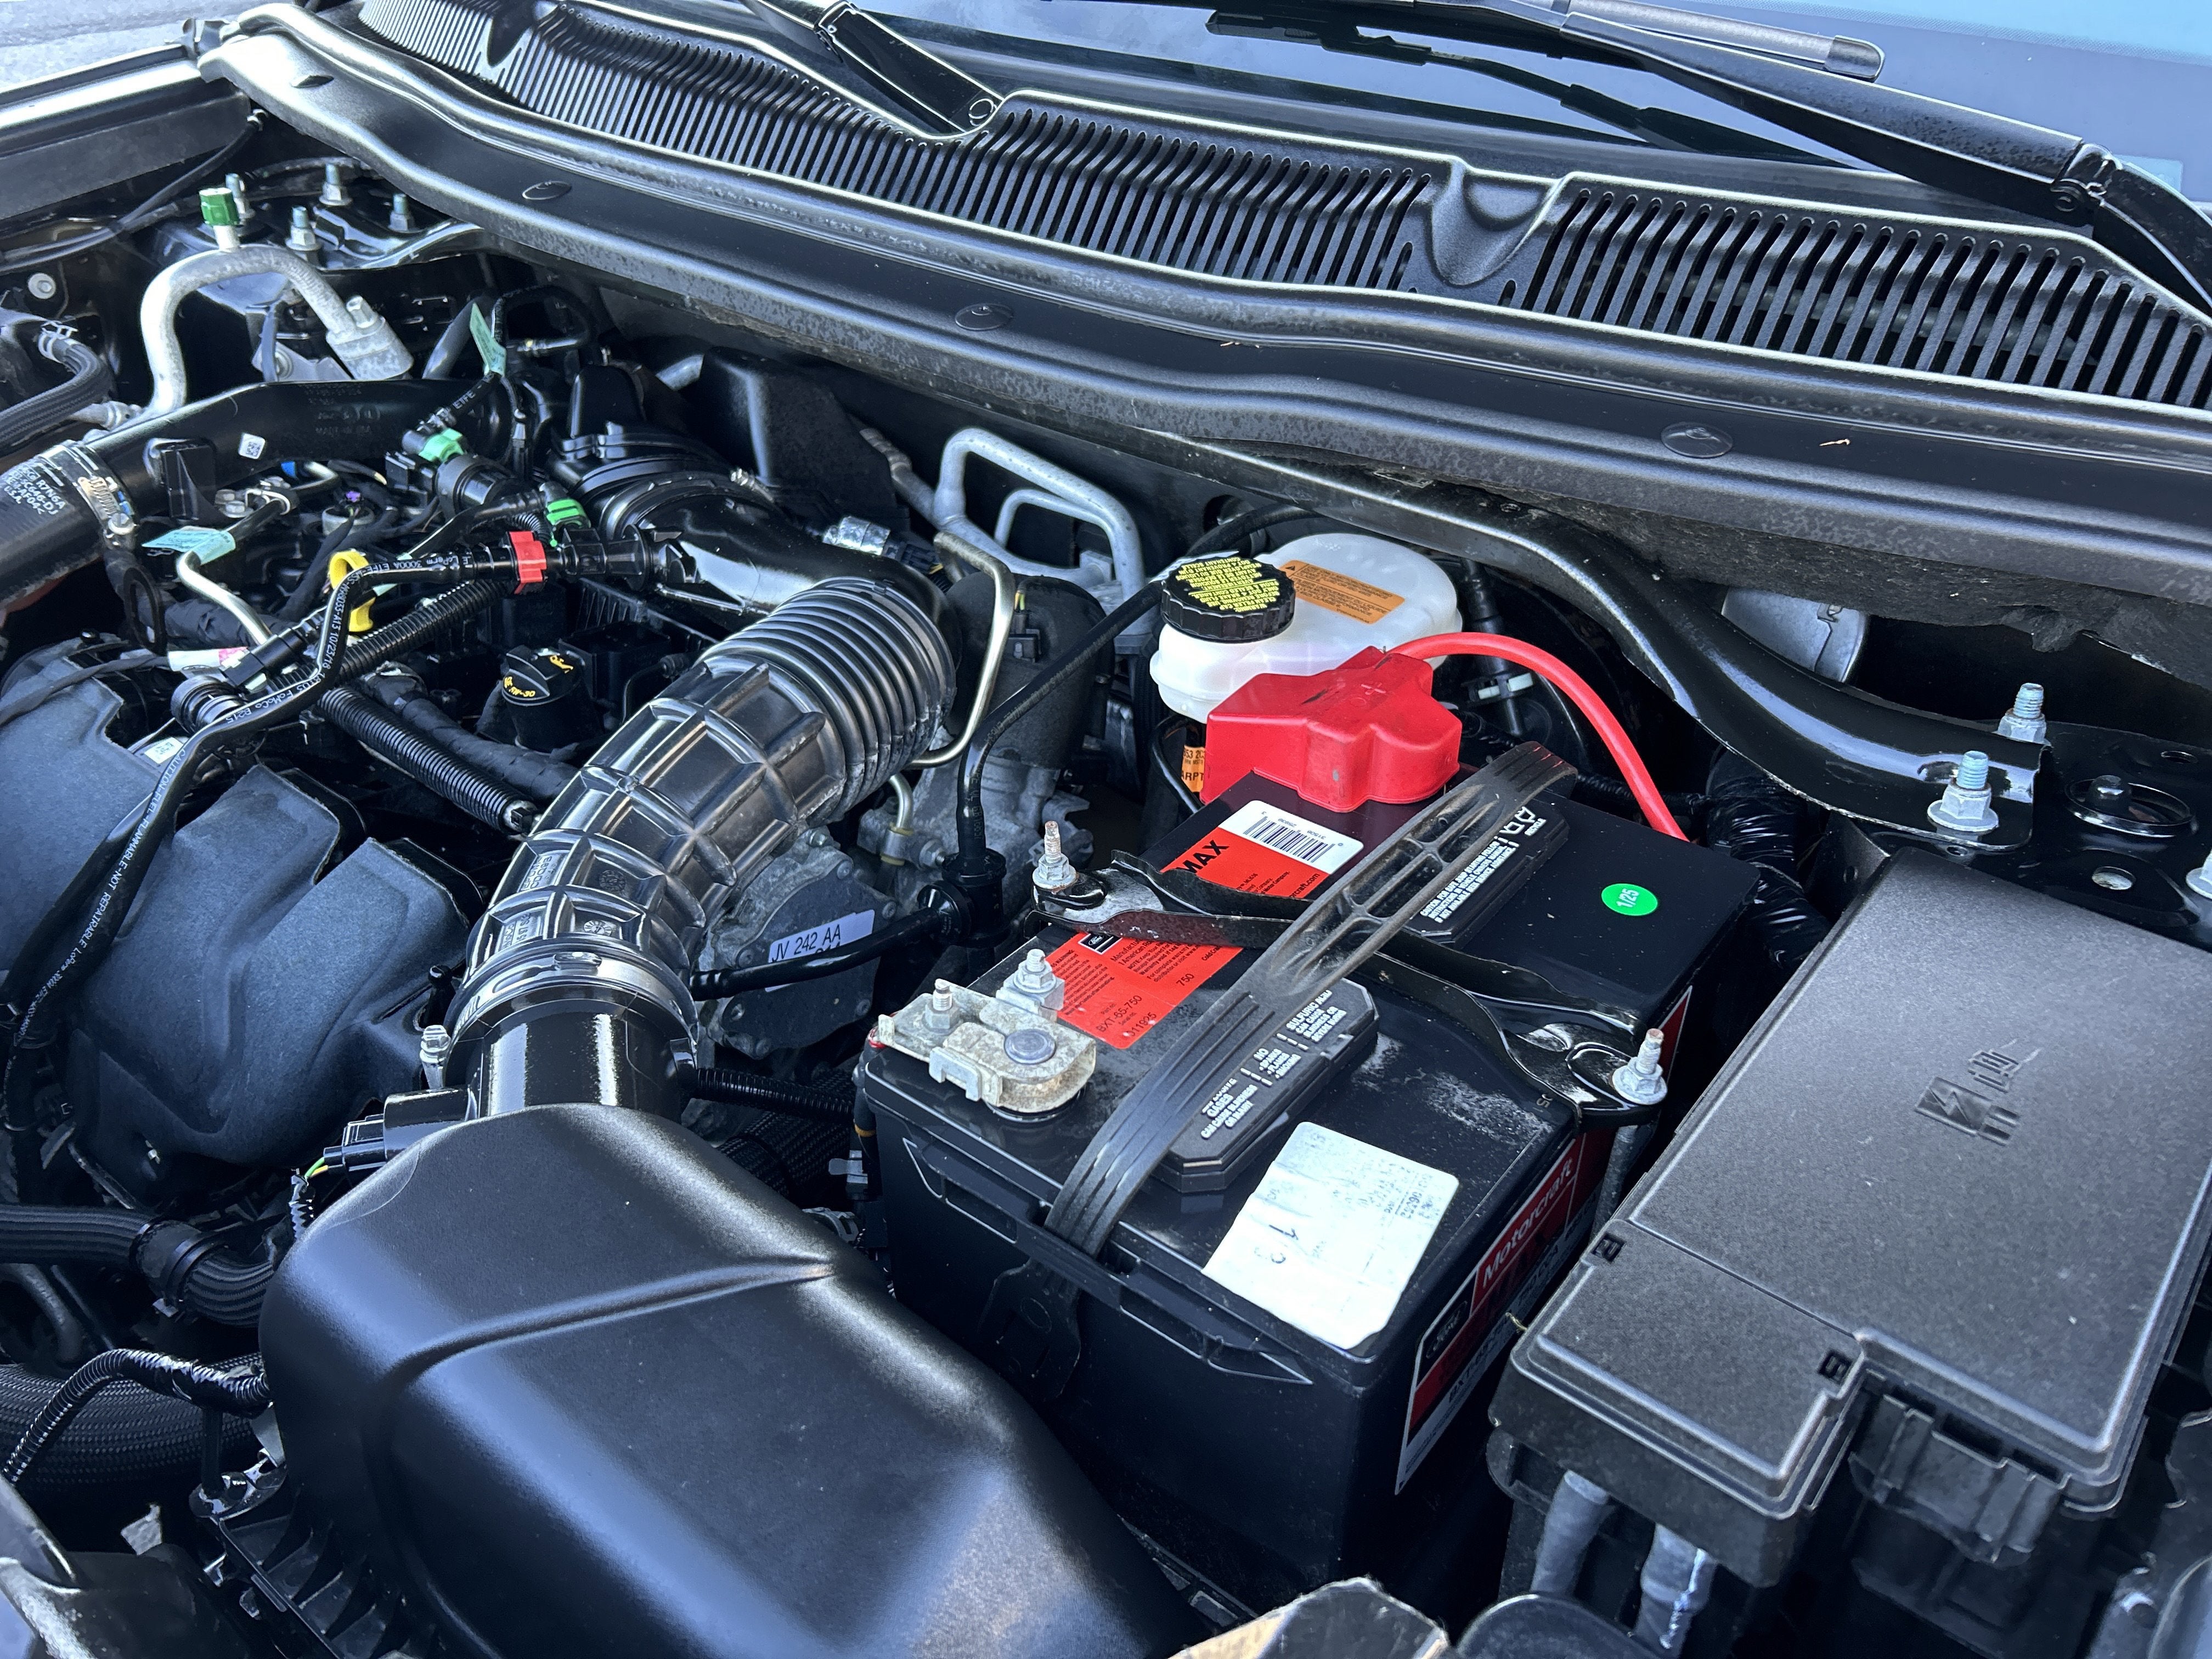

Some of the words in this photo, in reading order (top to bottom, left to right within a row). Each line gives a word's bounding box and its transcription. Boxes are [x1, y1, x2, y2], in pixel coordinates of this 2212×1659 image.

[254, 686, 294, 714] FoMoCo
[1176, 839, 1229, 874] MAX
[1616, 888, 1639, 908] 1/25
[794, 932, 817, 955] 242
[823, 924, 841, 946] AA
[1120, 944, 1146, 964] American
[1175, 970, 1195, 989] 750
[1095, 992, 1143, 1034] BXT-65-750
[1252, 1047, 1269, 1061] NO
[1205, 1092, 1234, 1119] GASES
[1199, 1123, 1217, 1138] CAN
[1484, 1152, 1576, 1288] Motorcraft
